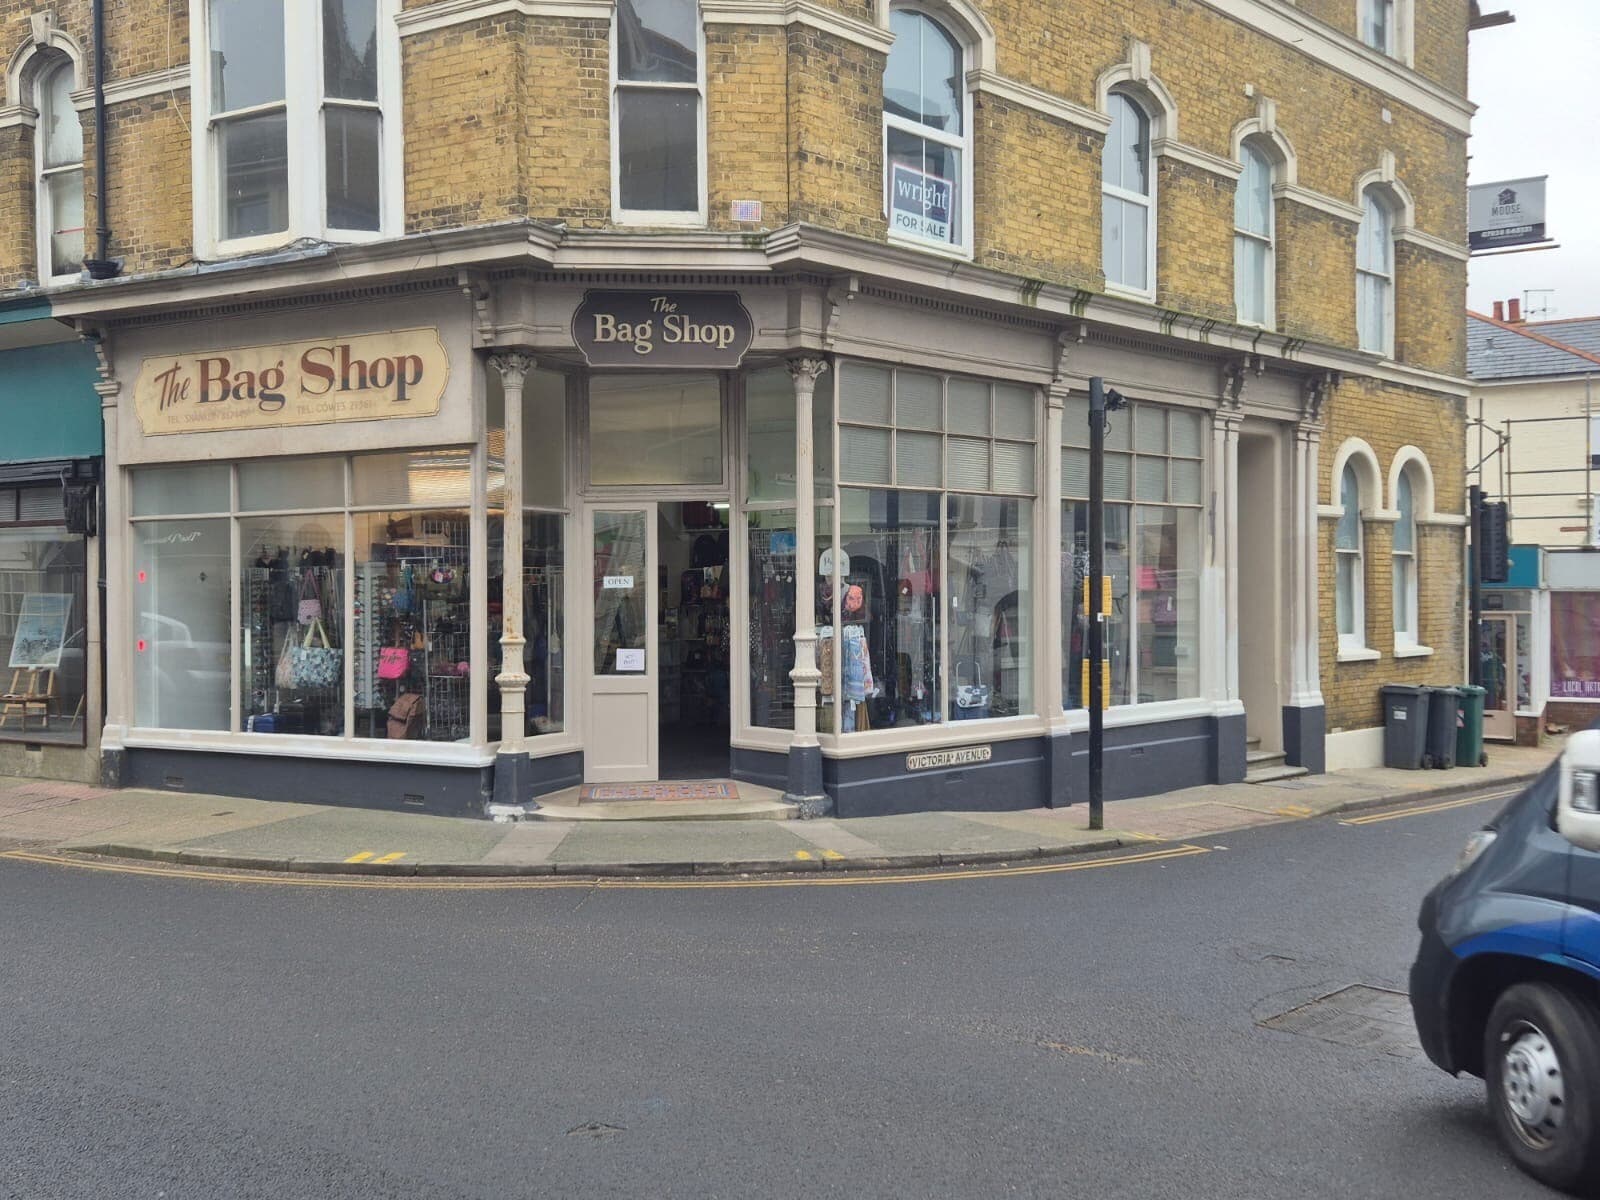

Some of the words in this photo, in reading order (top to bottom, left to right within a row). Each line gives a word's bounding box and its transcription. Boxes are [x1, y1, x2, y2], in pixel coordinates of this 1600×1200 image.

[898, 179, 947, 210] wright
[1491, 204, 1521, 216] MOOSE
[896, 214, 917, 230] FOR
[920, 221, 945, 238] SALE
[650, 296, 677, 313] The
[593, 313, 653, 354] Bag
[663, 314, 735, 349] Shop
[154, 361, 191, 411] The
[195, 356, 286, 412] Bag
[300, 345, 424, 402] Shop
[607, 578, 630, 586] OPEN
[912, 753, 952, 768] VICTORIA
[956, 747, 988, 762] AVENUE
